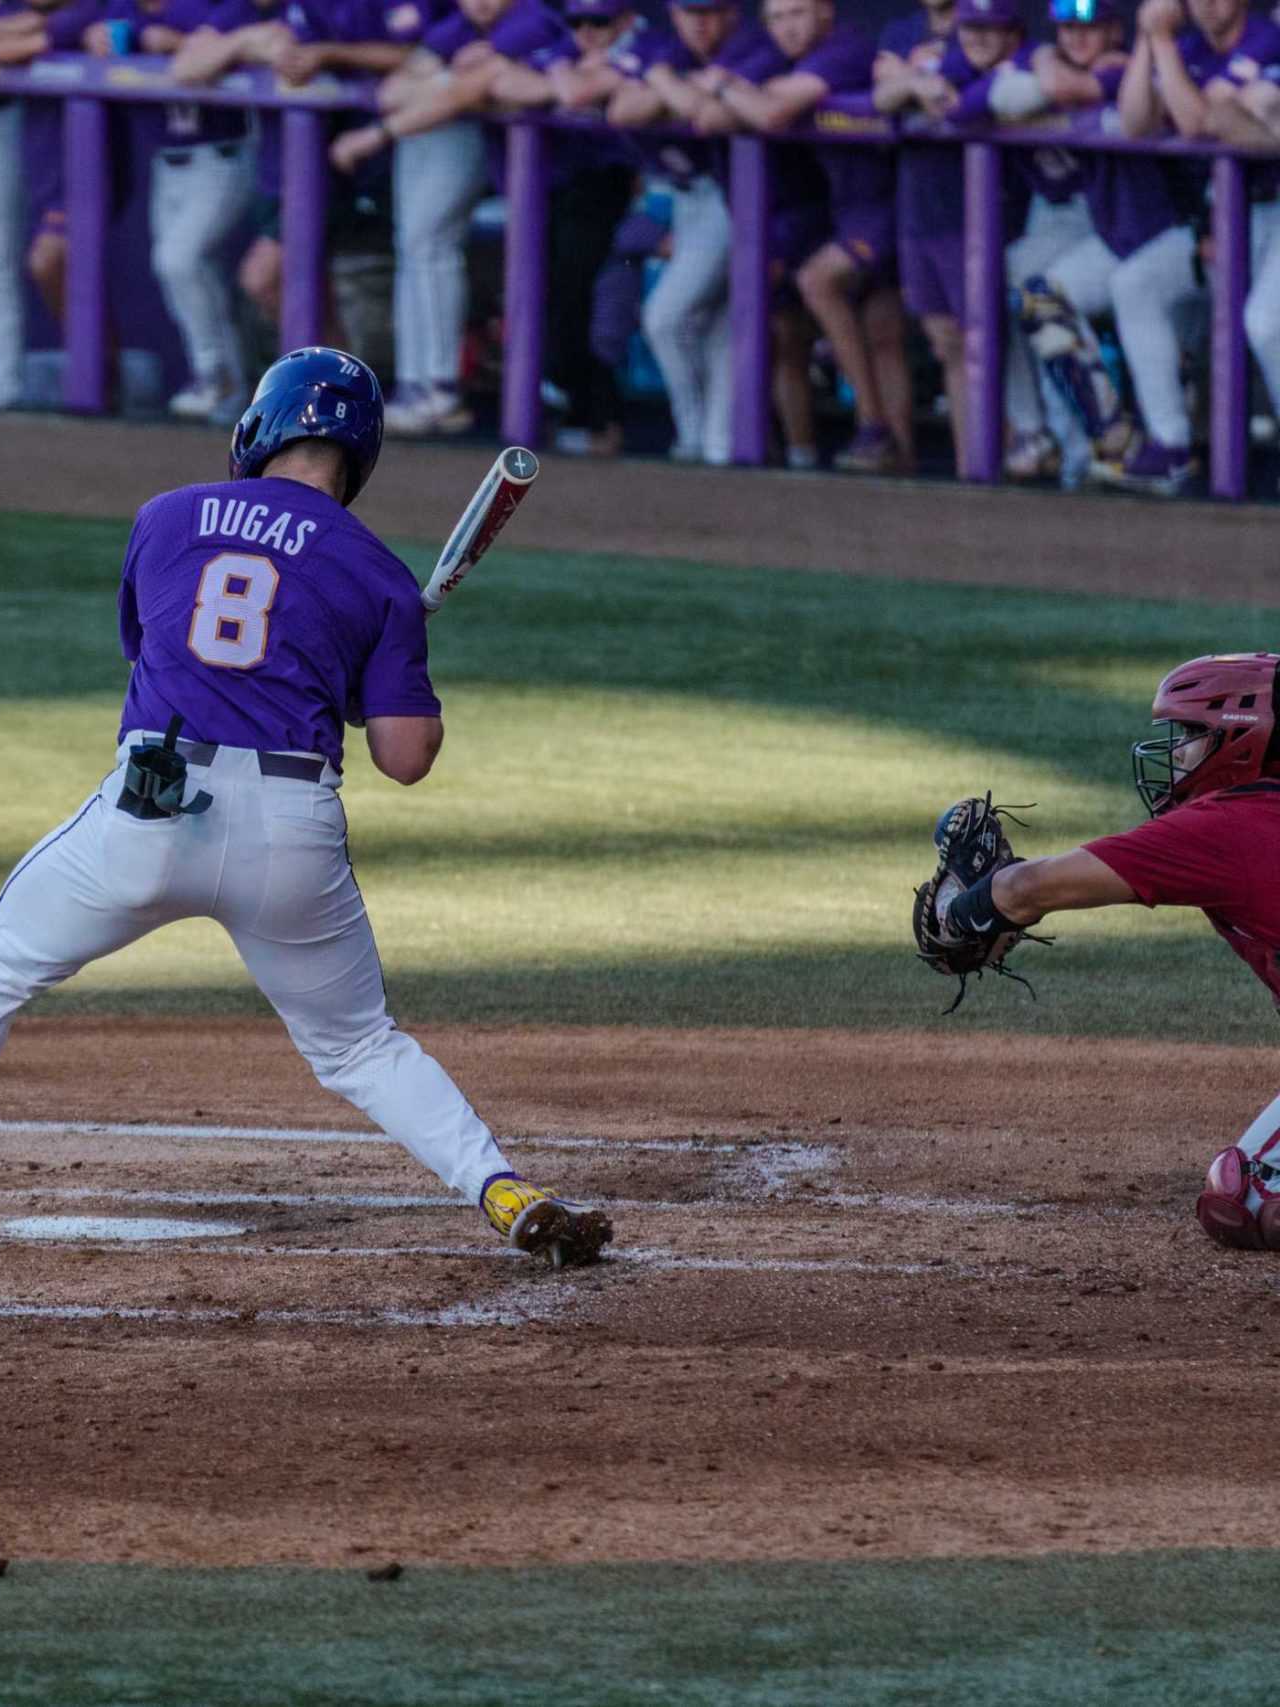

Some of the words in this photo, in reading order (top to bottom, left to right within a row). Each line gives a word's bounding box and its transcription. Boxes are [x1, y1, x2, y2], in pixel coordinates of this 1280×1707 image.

[335, 402, 347, 419] 8
[199, 497, 318, 556] DUGAS
[187, 551, 280, 670] 8
